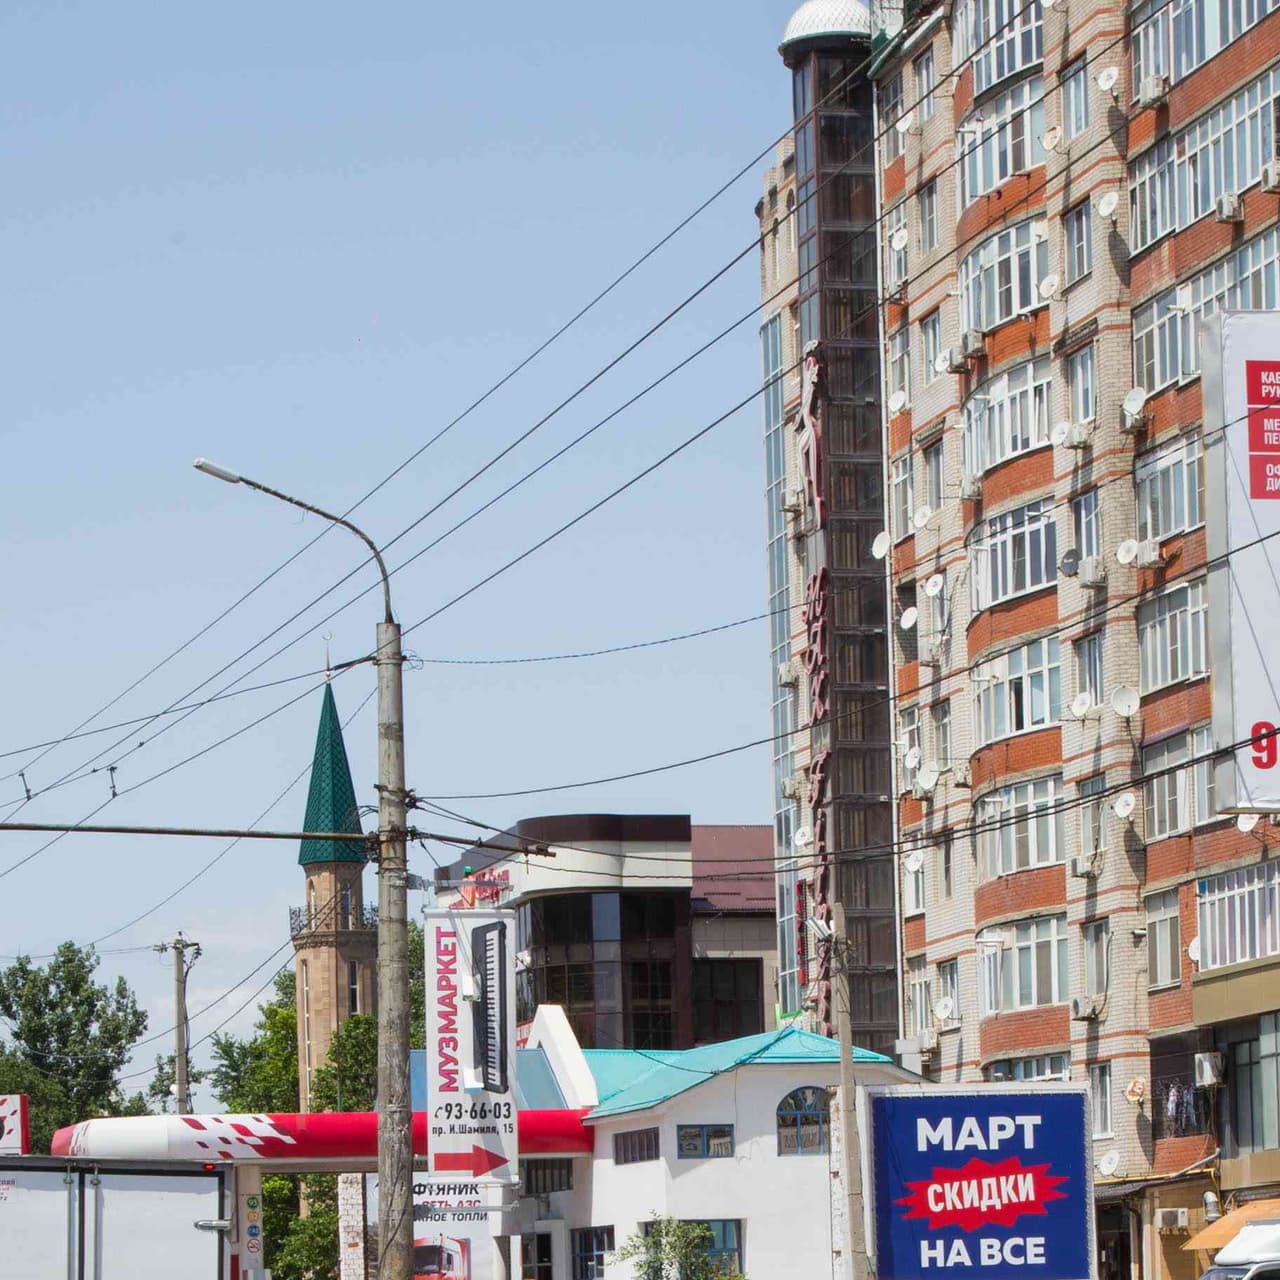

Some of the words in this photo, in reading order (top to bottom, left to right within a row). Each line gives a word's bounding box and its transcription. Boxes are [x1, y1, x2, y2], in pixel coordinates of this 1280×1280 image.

[432, 1126, 446, 1137] пр.
[503, 1123, 514, 1134] 15
[916, 1115, 1042, 1152] МАРТ
[413, 1183, 480, 1196] ФТЯНИК
[926, 1173, 1036, 1213] СКИДКИ
[920, 1239, 972, 1268] НА
[979, 1236, 1046, 1266] ВСЕ
